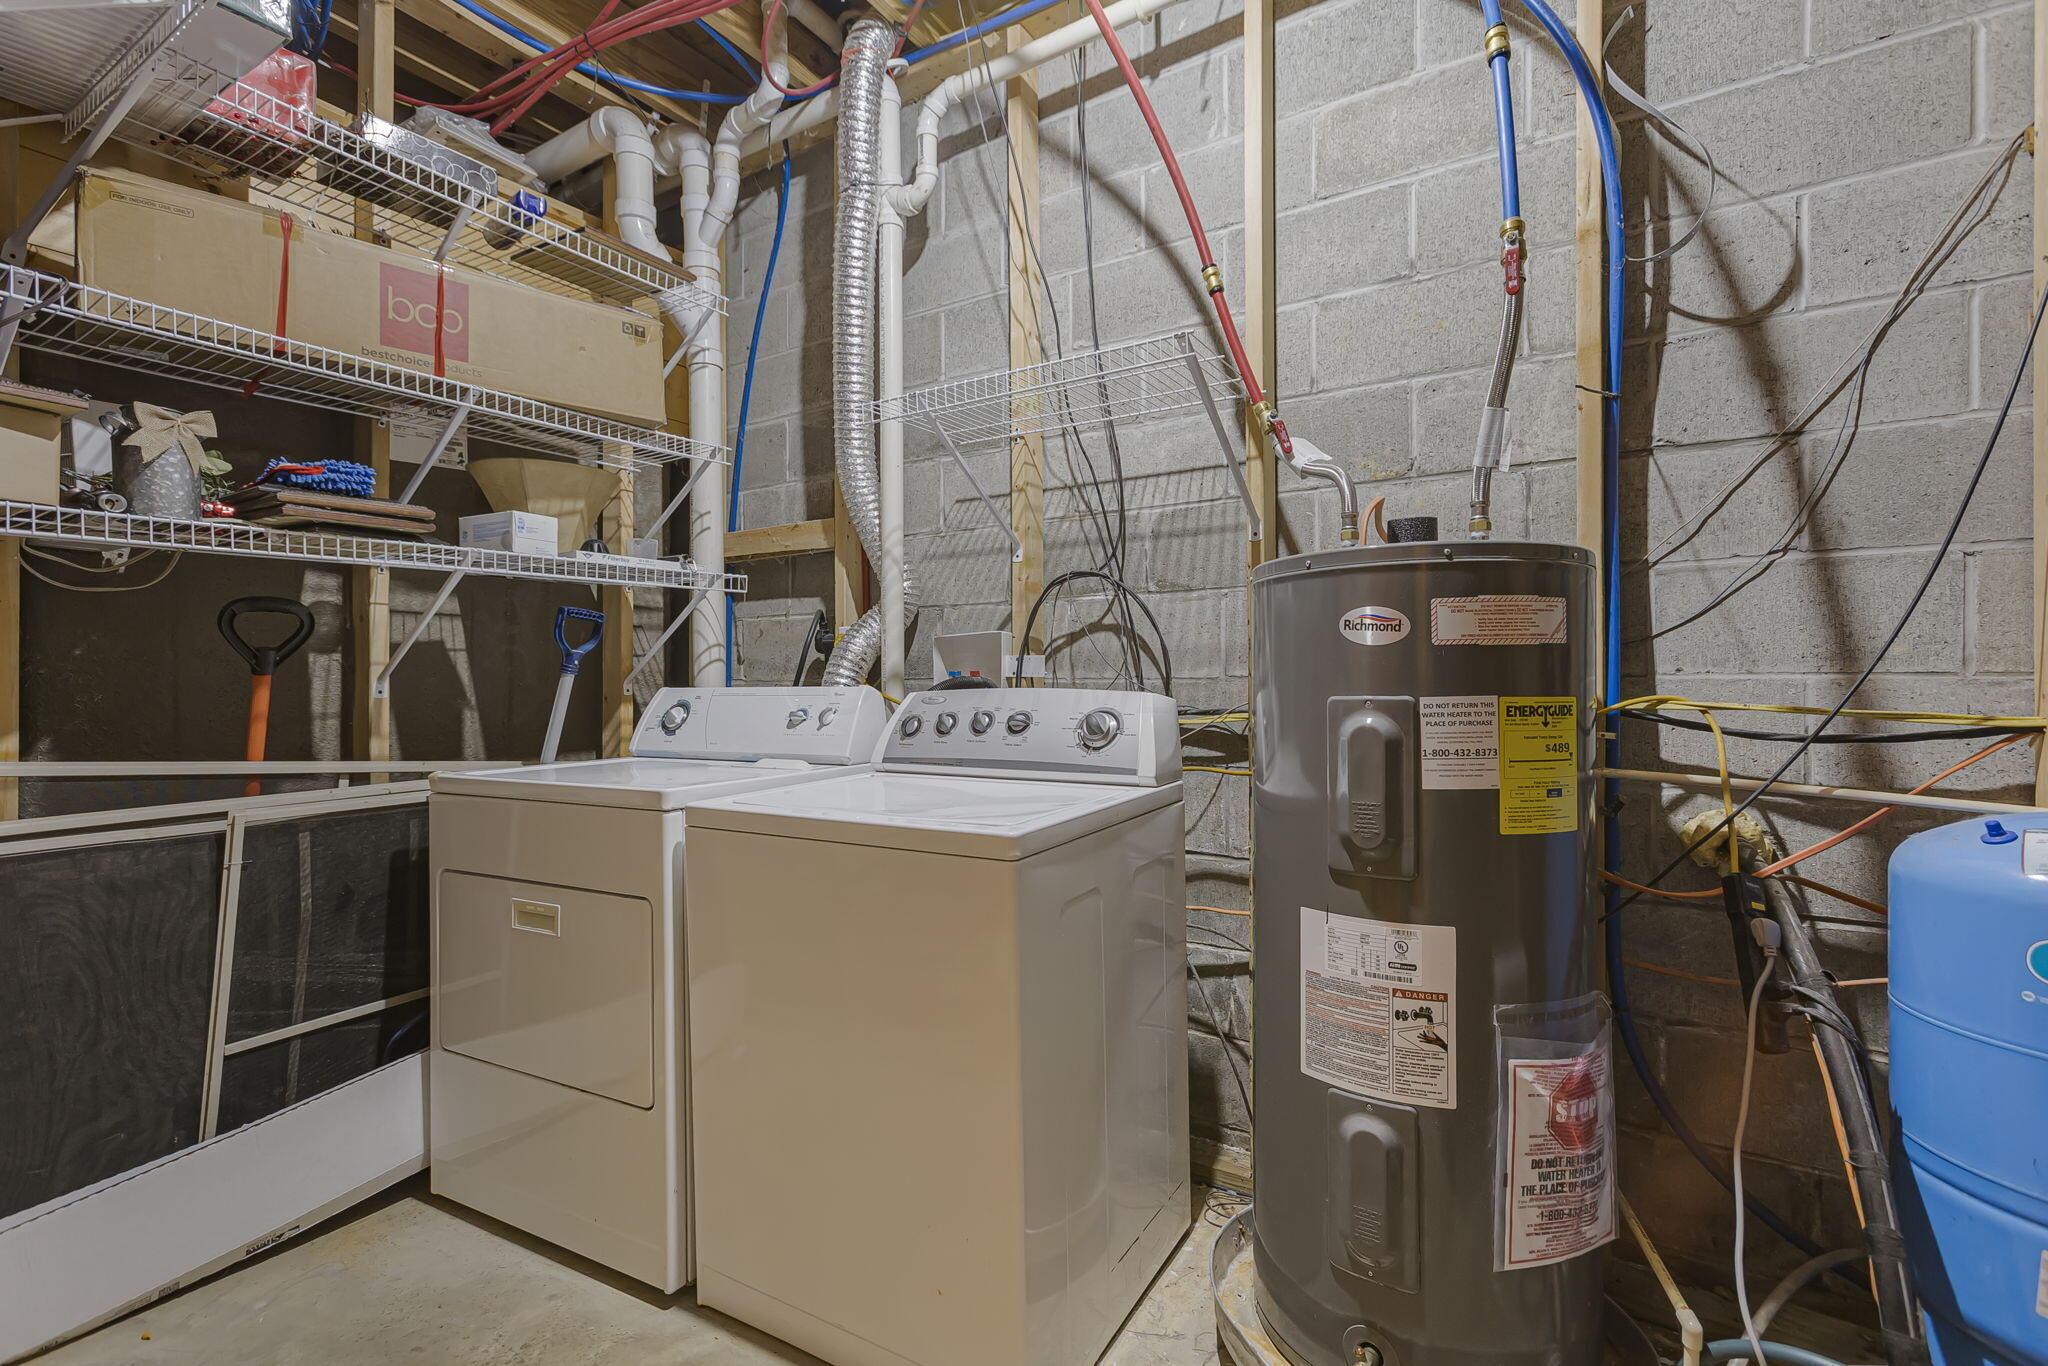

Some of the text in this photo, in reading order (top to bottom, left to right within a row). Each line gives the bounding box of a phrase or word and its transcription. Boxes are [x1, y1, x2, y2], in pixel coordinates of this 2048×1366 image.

[1343, 618, 1402, 632] Richmond
[1505, 704, 1574, 718] ENERGYGUIDE
[1422, 748, 1498, 758] 1-800-432-8373
[1545, 742, 1570, 753] $489
[1405, 991, 1445, 1001] DANGER
[1556, 1097, 1597, 1123] STOP
[1531, 1158, 1544, 1170] DO
[1546, 1157, 1562, 1169] NOT
[1538, 1170, 1566, 1182] WATER
[1521, 1185, 1538, 1197] THE
[1540, 1182, 1567, 1196] PLACE
